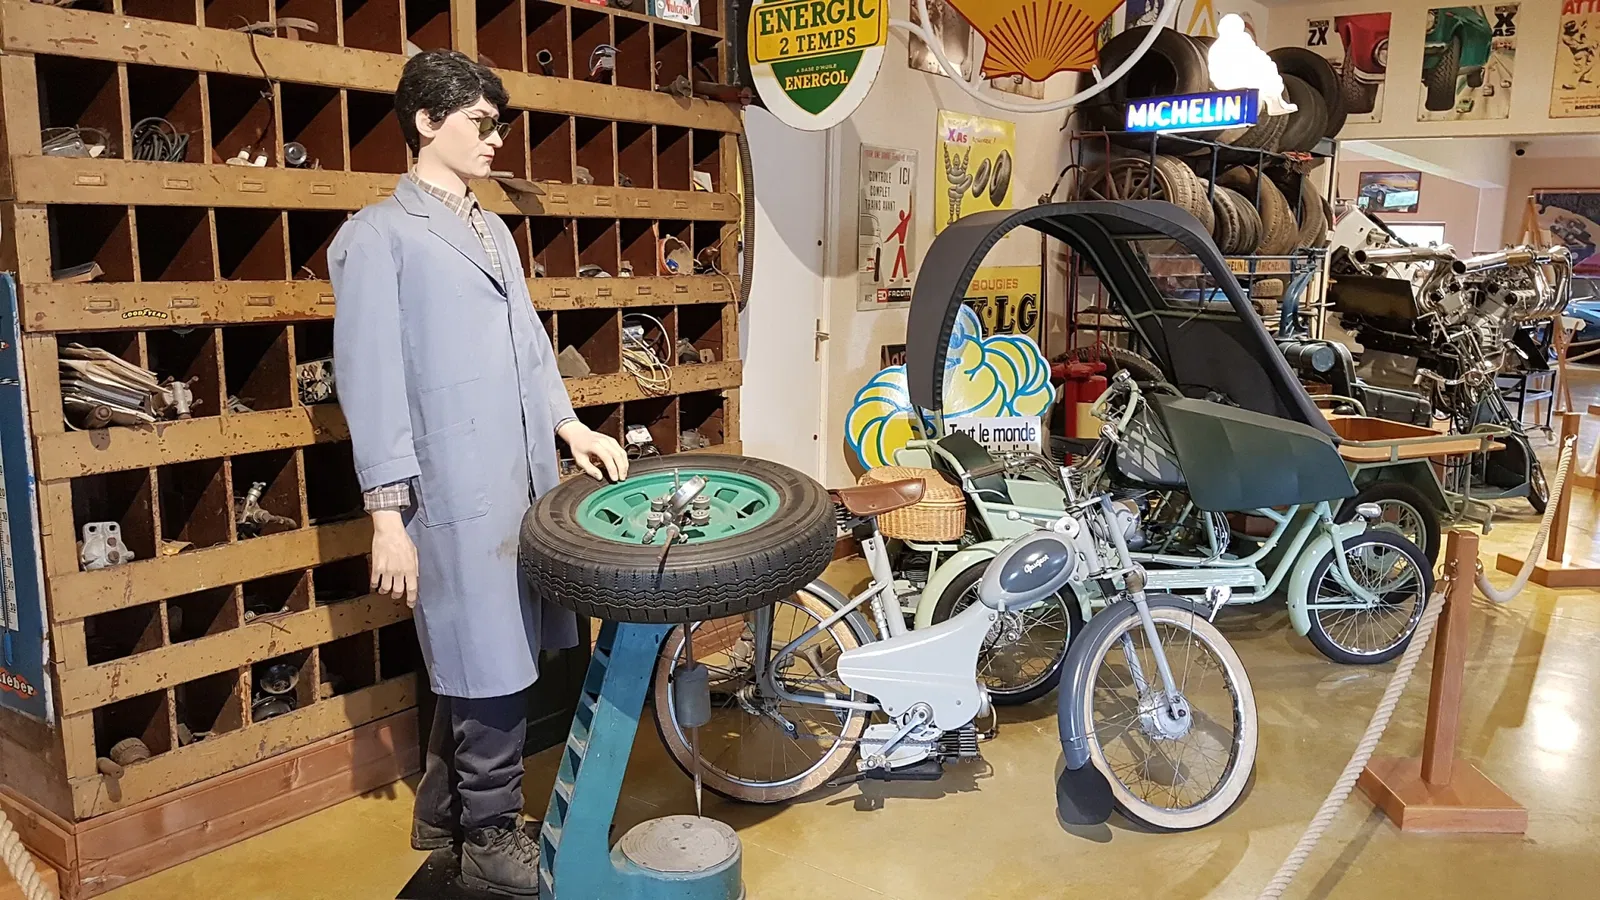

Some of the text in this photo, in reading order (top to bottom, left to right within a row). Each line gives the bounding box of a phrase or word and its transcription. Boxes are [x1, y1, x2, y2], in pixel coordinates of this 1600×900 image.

[759, 0, 876, 36] ENERGIC
[780, 27, 856, 55] 2 TEMPS
[1307, 27, 1329, 46] ZX
[1492, 28, 1516, 37] AS
[785, 70, 849, 91] ENERGOL
[1127, 95, 1241, 128] MICHELIN
[899, 167, 910, 185] ICI
[870, 185, 891, 197] COMPLET
[888, 289, 911, 297] FACOM
[972, 278, 1019, 291] BOUGIES
[979, 423, 990, 442] le
[993, 422, 1036, 442] monde
[0, 671, 34, 695] leber
